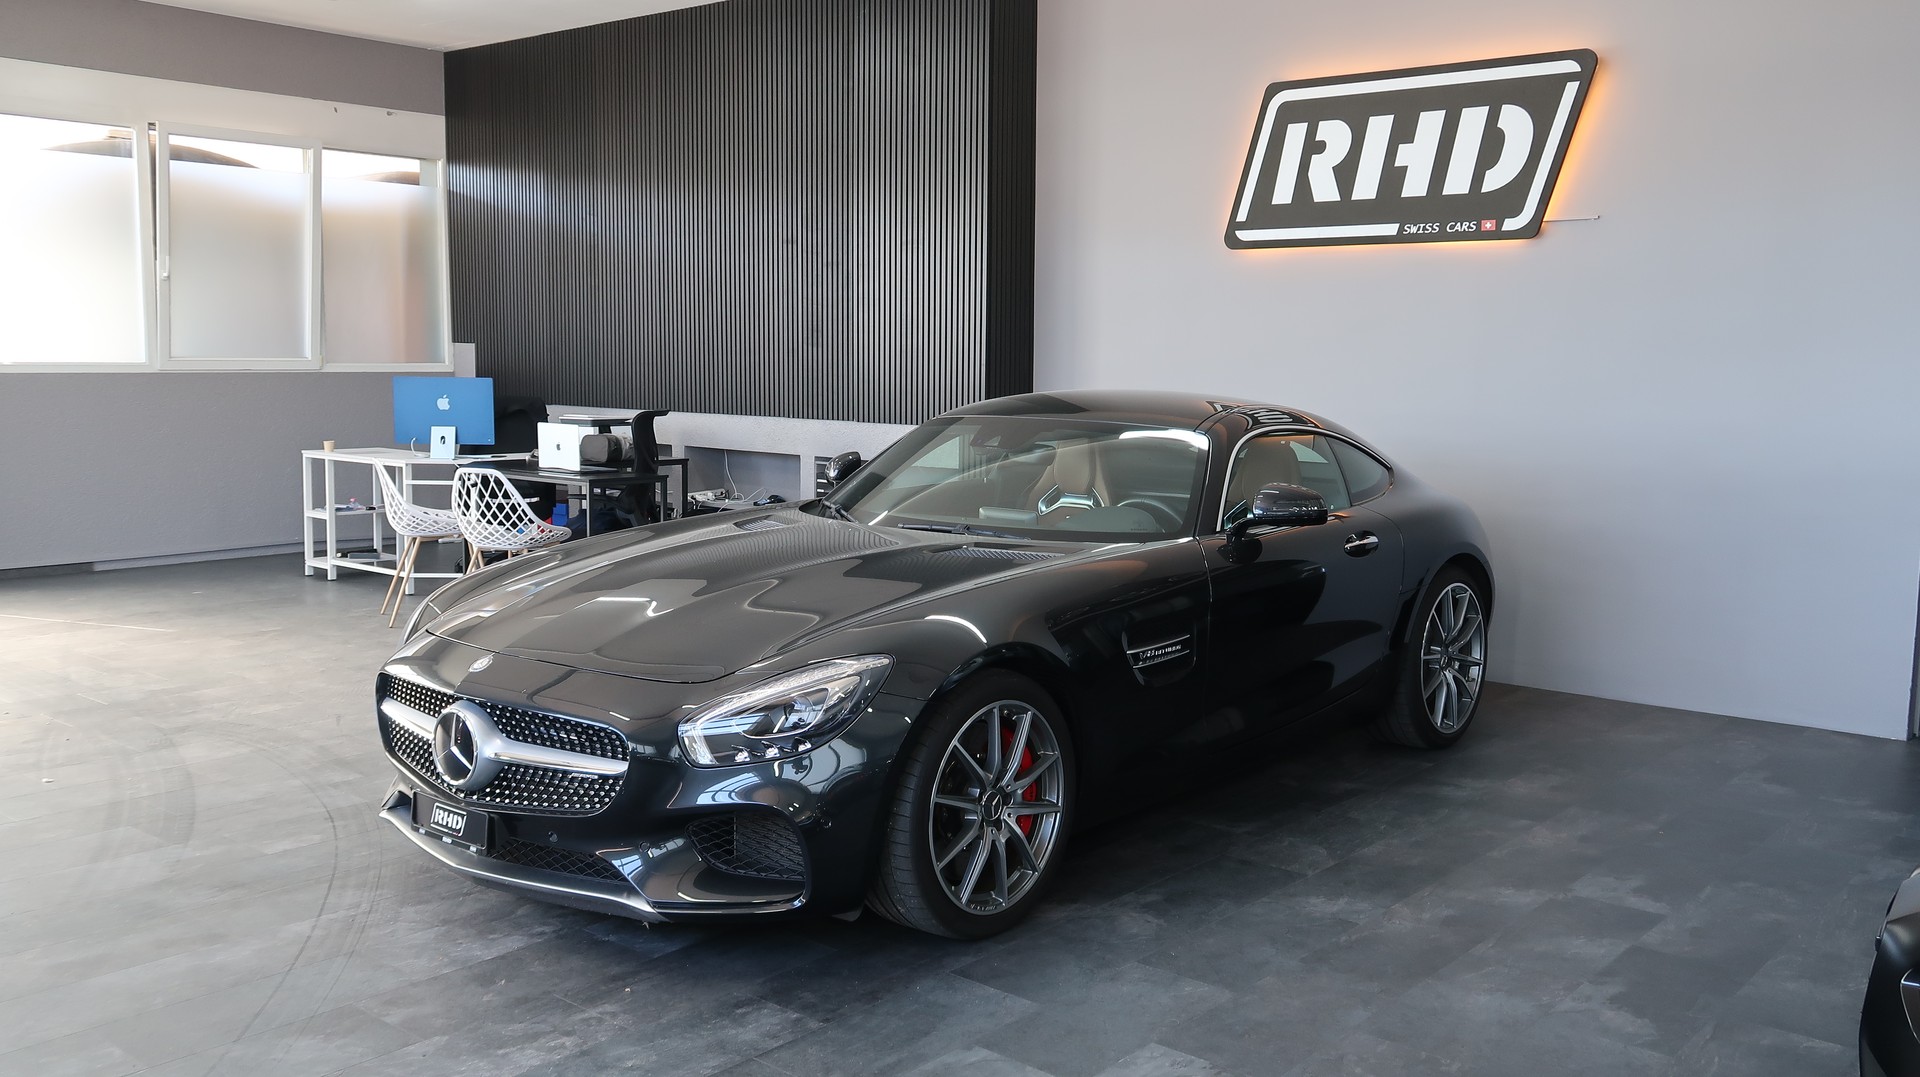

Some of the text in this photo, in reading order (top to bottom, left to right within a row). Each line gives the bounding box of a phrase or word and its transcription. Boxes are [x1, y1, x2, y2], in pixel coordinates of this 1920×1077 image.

[1272, 104, 1534, 205] RHD
[1402, 220, 1478, 235] SWISS CARS
[434, 808, 463, 830] RHD
